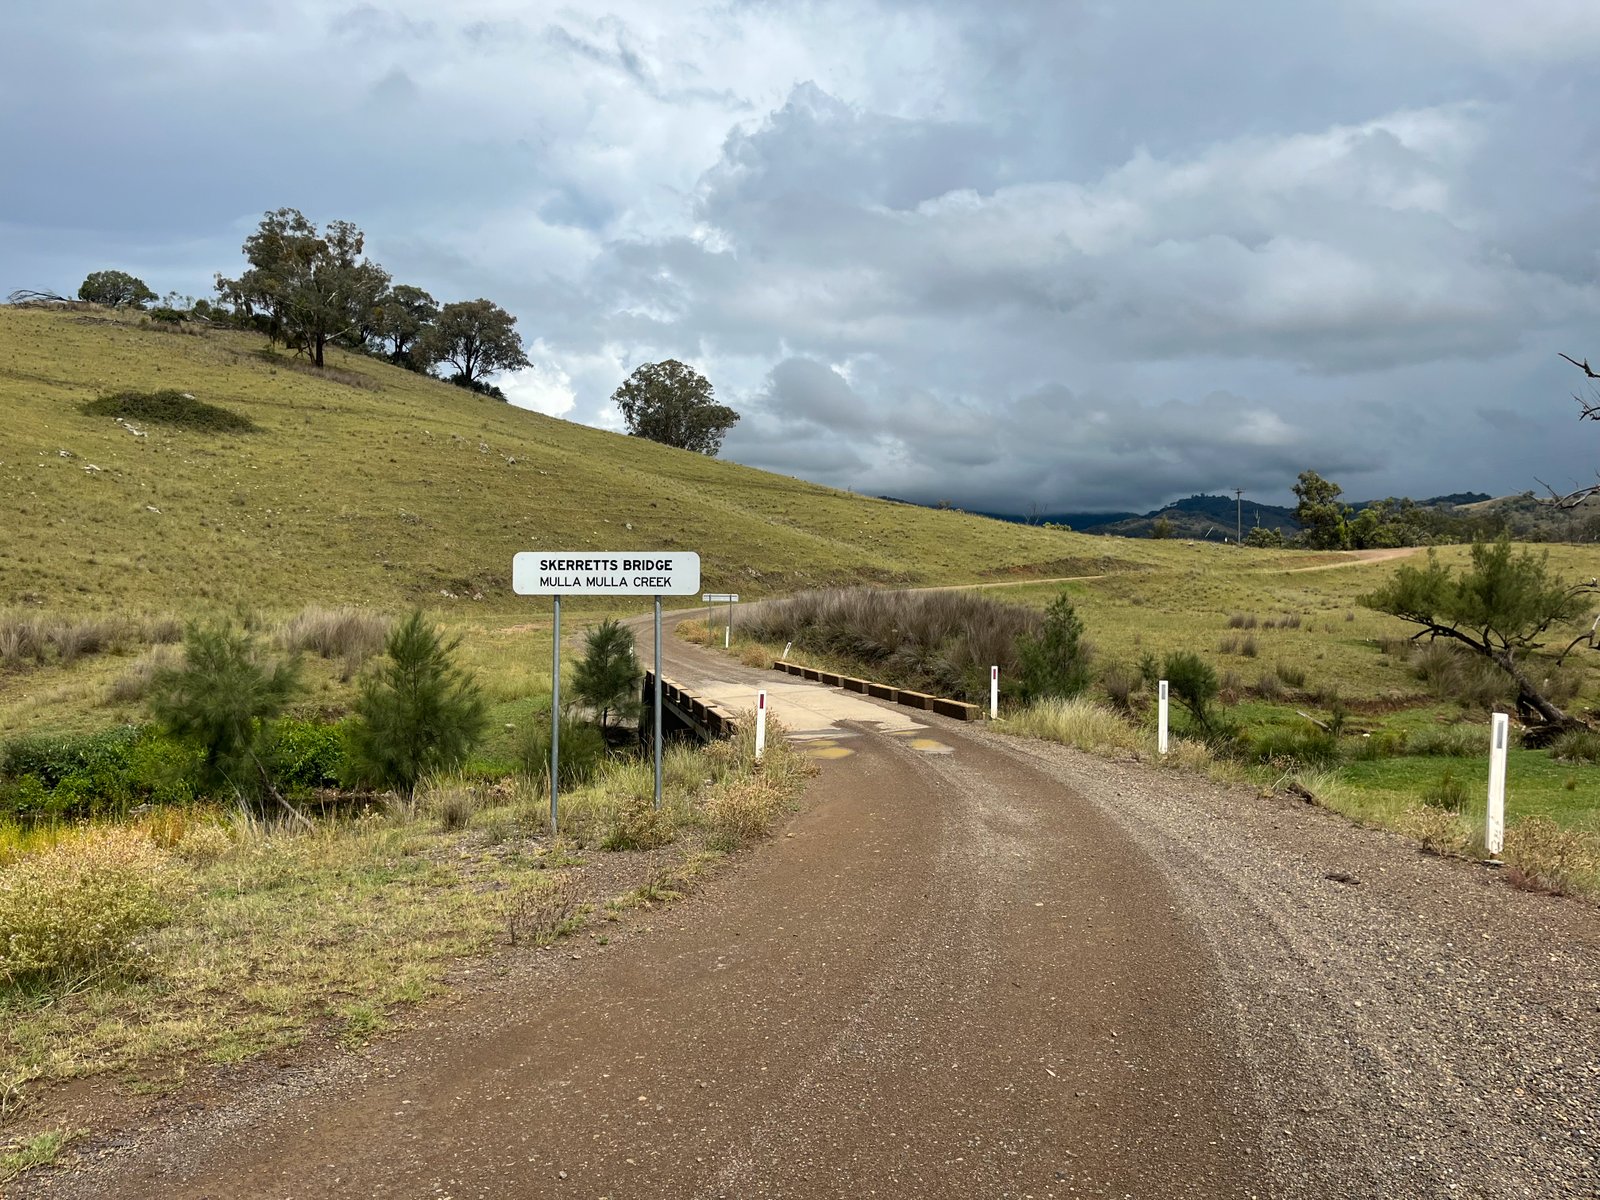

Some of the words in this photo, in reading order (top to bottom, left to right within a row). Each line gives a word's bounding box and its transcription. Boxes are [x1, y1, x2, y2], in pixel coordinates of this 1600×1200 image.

[540, 560, 618, 571] SKERRETTS
[623, 560, 673, 571] BRIDGE
[540, 577, 581, 587] MULLA
[586, 577, 628, 587] MULLA
[633, 577, 672, 587] CREEK
